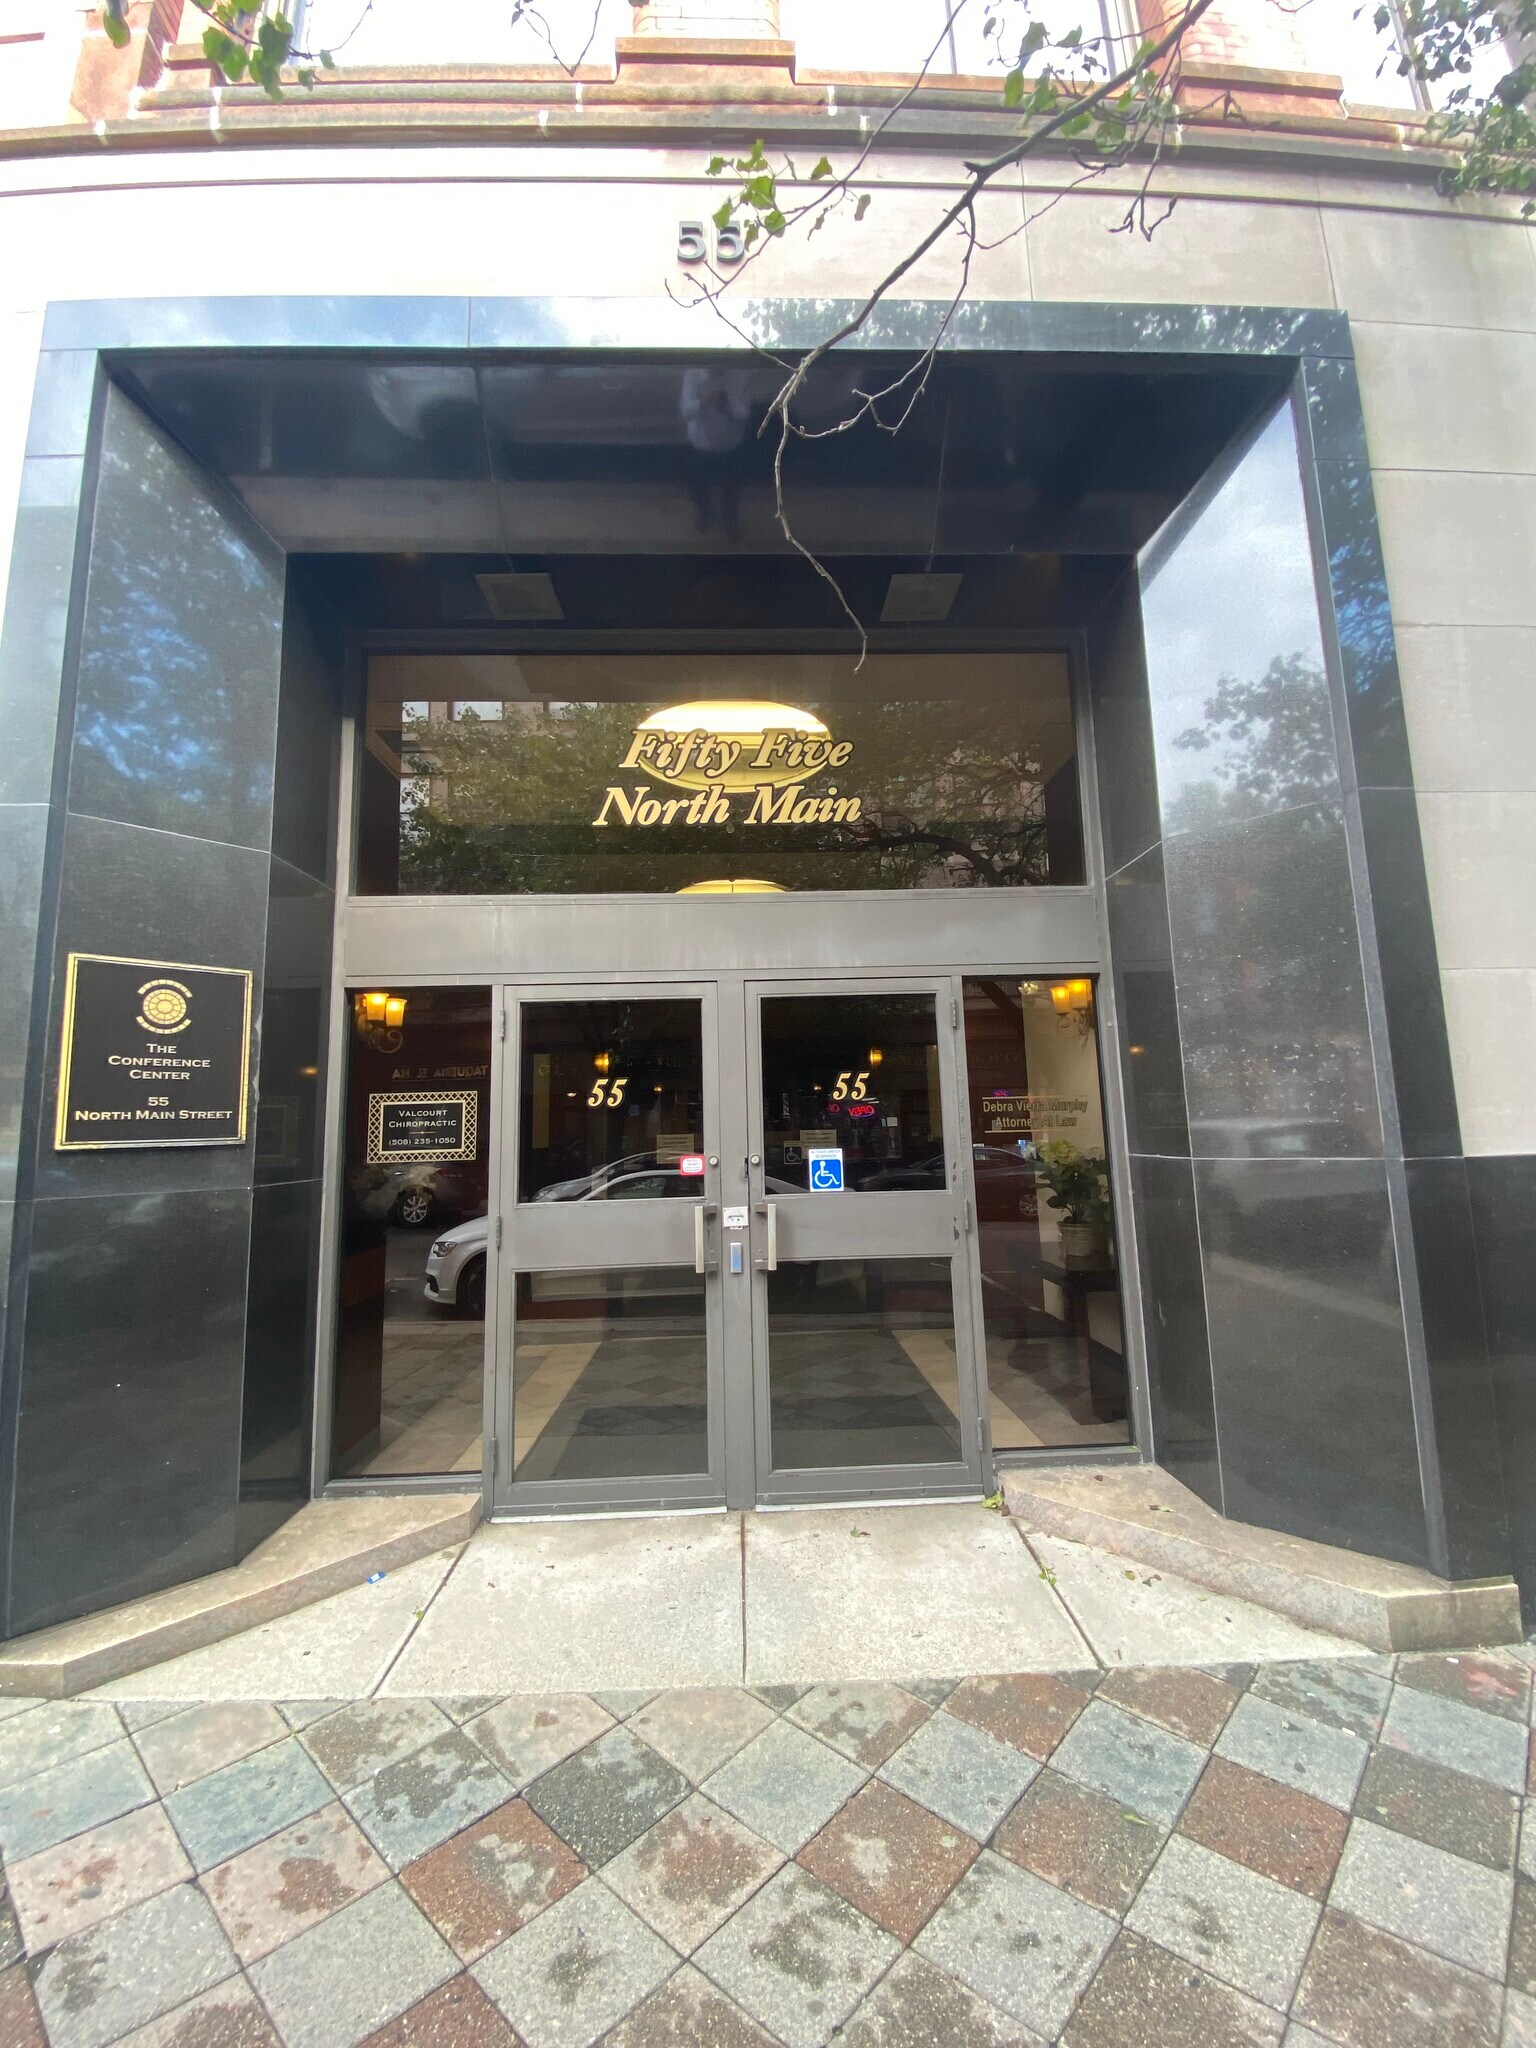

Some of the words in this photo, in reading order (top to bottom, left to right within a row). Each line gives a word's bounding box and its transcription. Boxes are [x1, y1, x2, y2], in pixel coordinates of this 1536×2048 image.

[677, 220, 745, 264] 55
[618, 728, 742, 778] Fifty
[750, 727, 855, 768] Five
[592, 784, 730, 826] North
[743, 784, 862, 825] Main
[147, 1043, 177, 1054] THE
[108, 1055, 211, 1068] CONFERENCE
[129, 1069, 190, 1080] CENTER
[831, 1071, 870, 1101] 55
[587, 1078, 628, 1108] 55
[147, 1096, 170, 1107] 55
[983, 1101, 1014, 1112] Debra
[1049, 1099, 1089, 1113] Murphy
[75, 1110, 132, 1121] NORTH
[135, 1110, 175, 1120] MAIN
[179, 1110, 233, 1120] STREET
[995, 1116, 1039, 1129] Attorney
[1041, 1115, 1053, 1126] At
[1056, 1115, 1078, 1126] Law
[388, 1120, 457, 1128] CHIROPRACTIC
[389, 1138, 412, 1146] (508)
[414, 1137, 456, 1145] 235-1050
